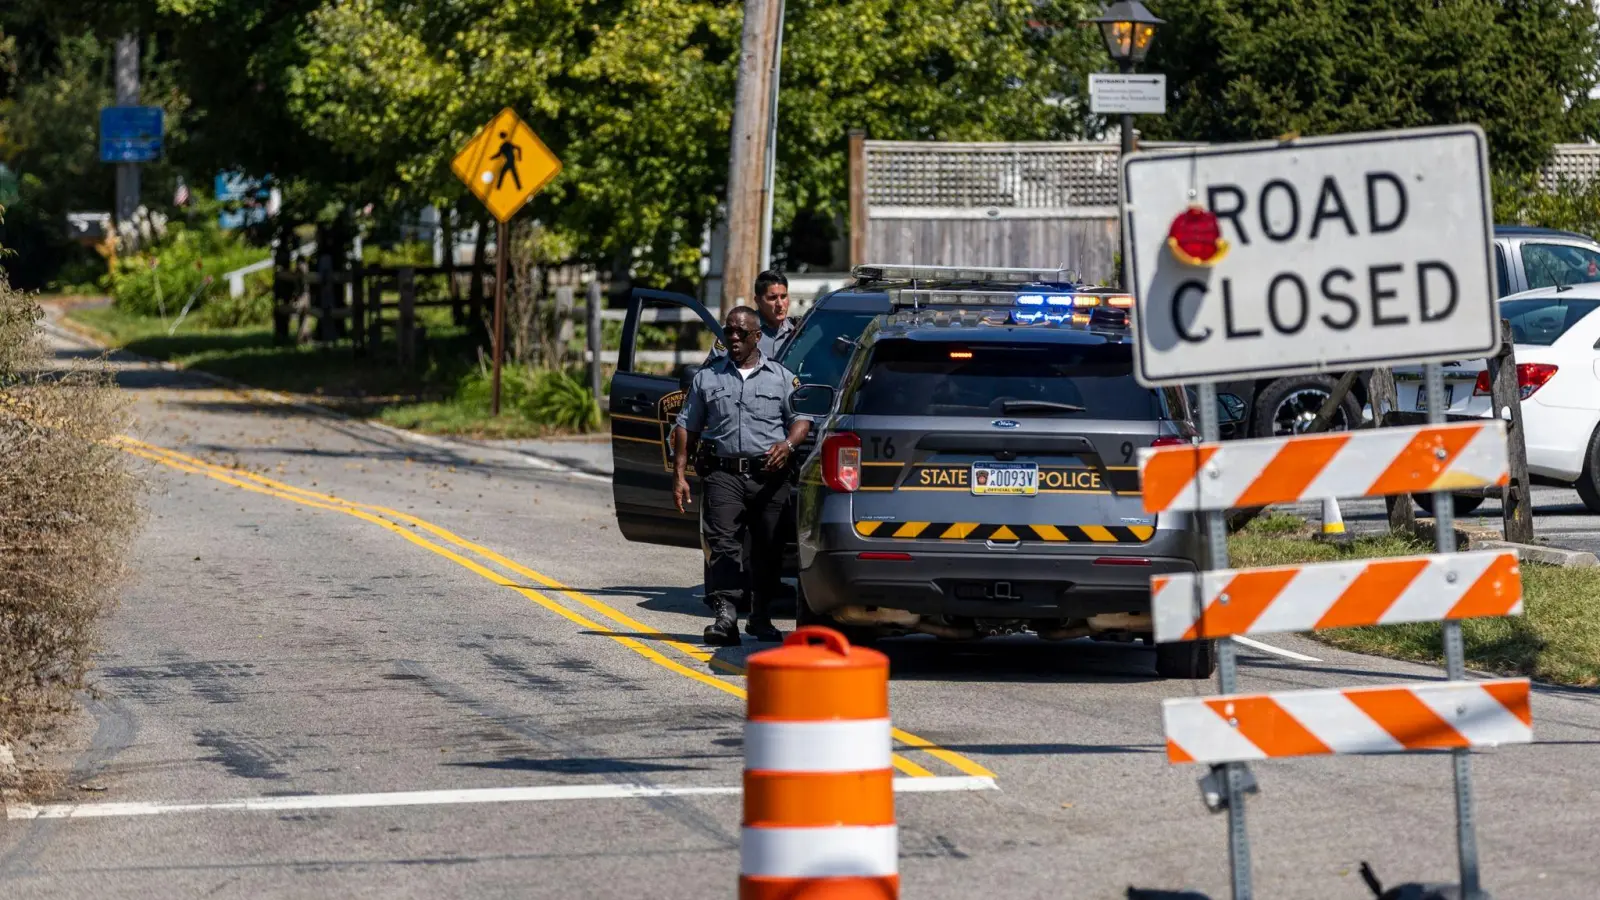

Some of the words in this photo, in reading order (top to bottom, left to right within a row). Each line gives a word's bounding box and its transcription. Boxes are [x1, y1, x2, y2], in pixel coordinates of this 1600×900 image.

[1207, 171, 1409, 245] ROAD
[1171, 260, 1460, 343] CLOSED
[663, 401, 681, 413] STATE
[870, 436, 895, 459] T6
[1121, 441, 1133, 463] 9
[919, 469, 968, 485] STATE
[1038, 471, 1101, 489] POLICE
[996, 470, 1034, 487] 0093V
